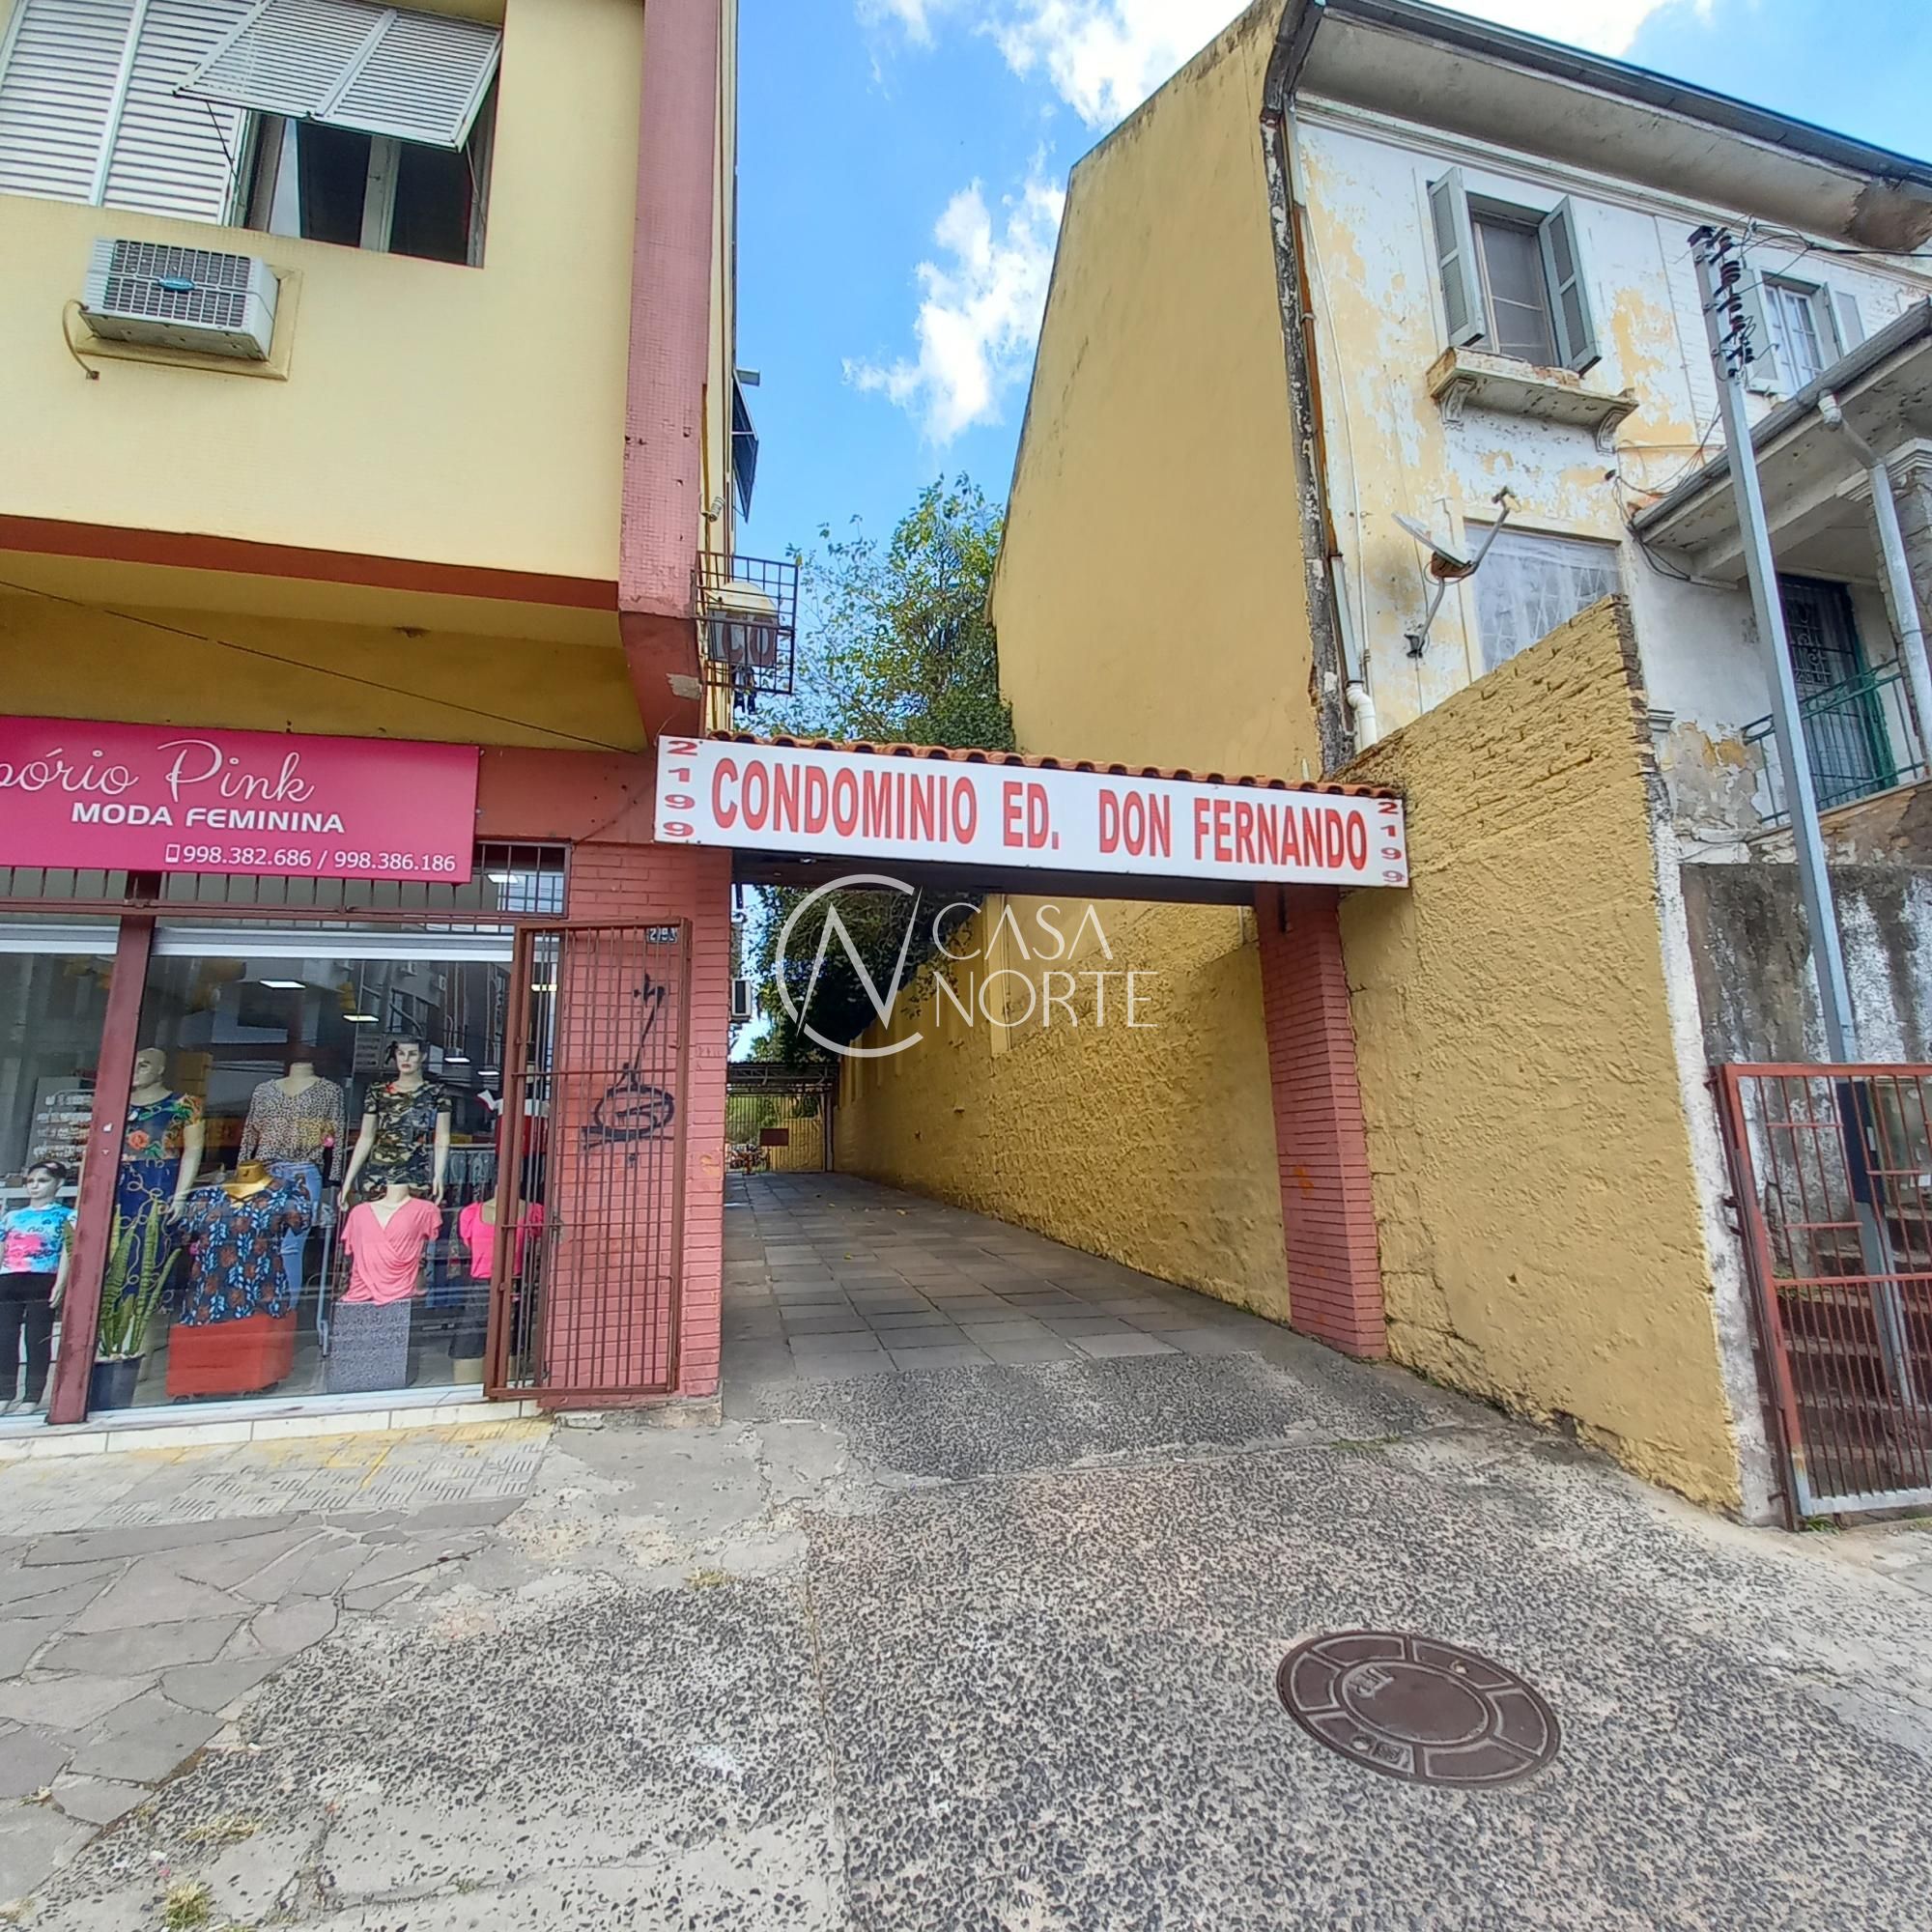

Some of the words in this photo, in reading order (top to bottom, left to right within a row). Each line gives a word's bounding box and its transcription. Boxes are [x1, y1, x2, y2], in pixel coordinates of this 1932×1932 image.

[156, 739, 316, 803] Pink
[71, 802, 174, 827] MODA
[185, 807, 346, 834] FEMININA
[711, 757, 978, 845] CONDOMINIO
[1002, 780, 1060, 850] ED.
[1098, 788, 1172, 858] DON
[1193, 797, 1368, 871] FERNANDO
[183, 845, 312, 867] 998.382.686
[334, 851, 456, 872] 998.386.186
